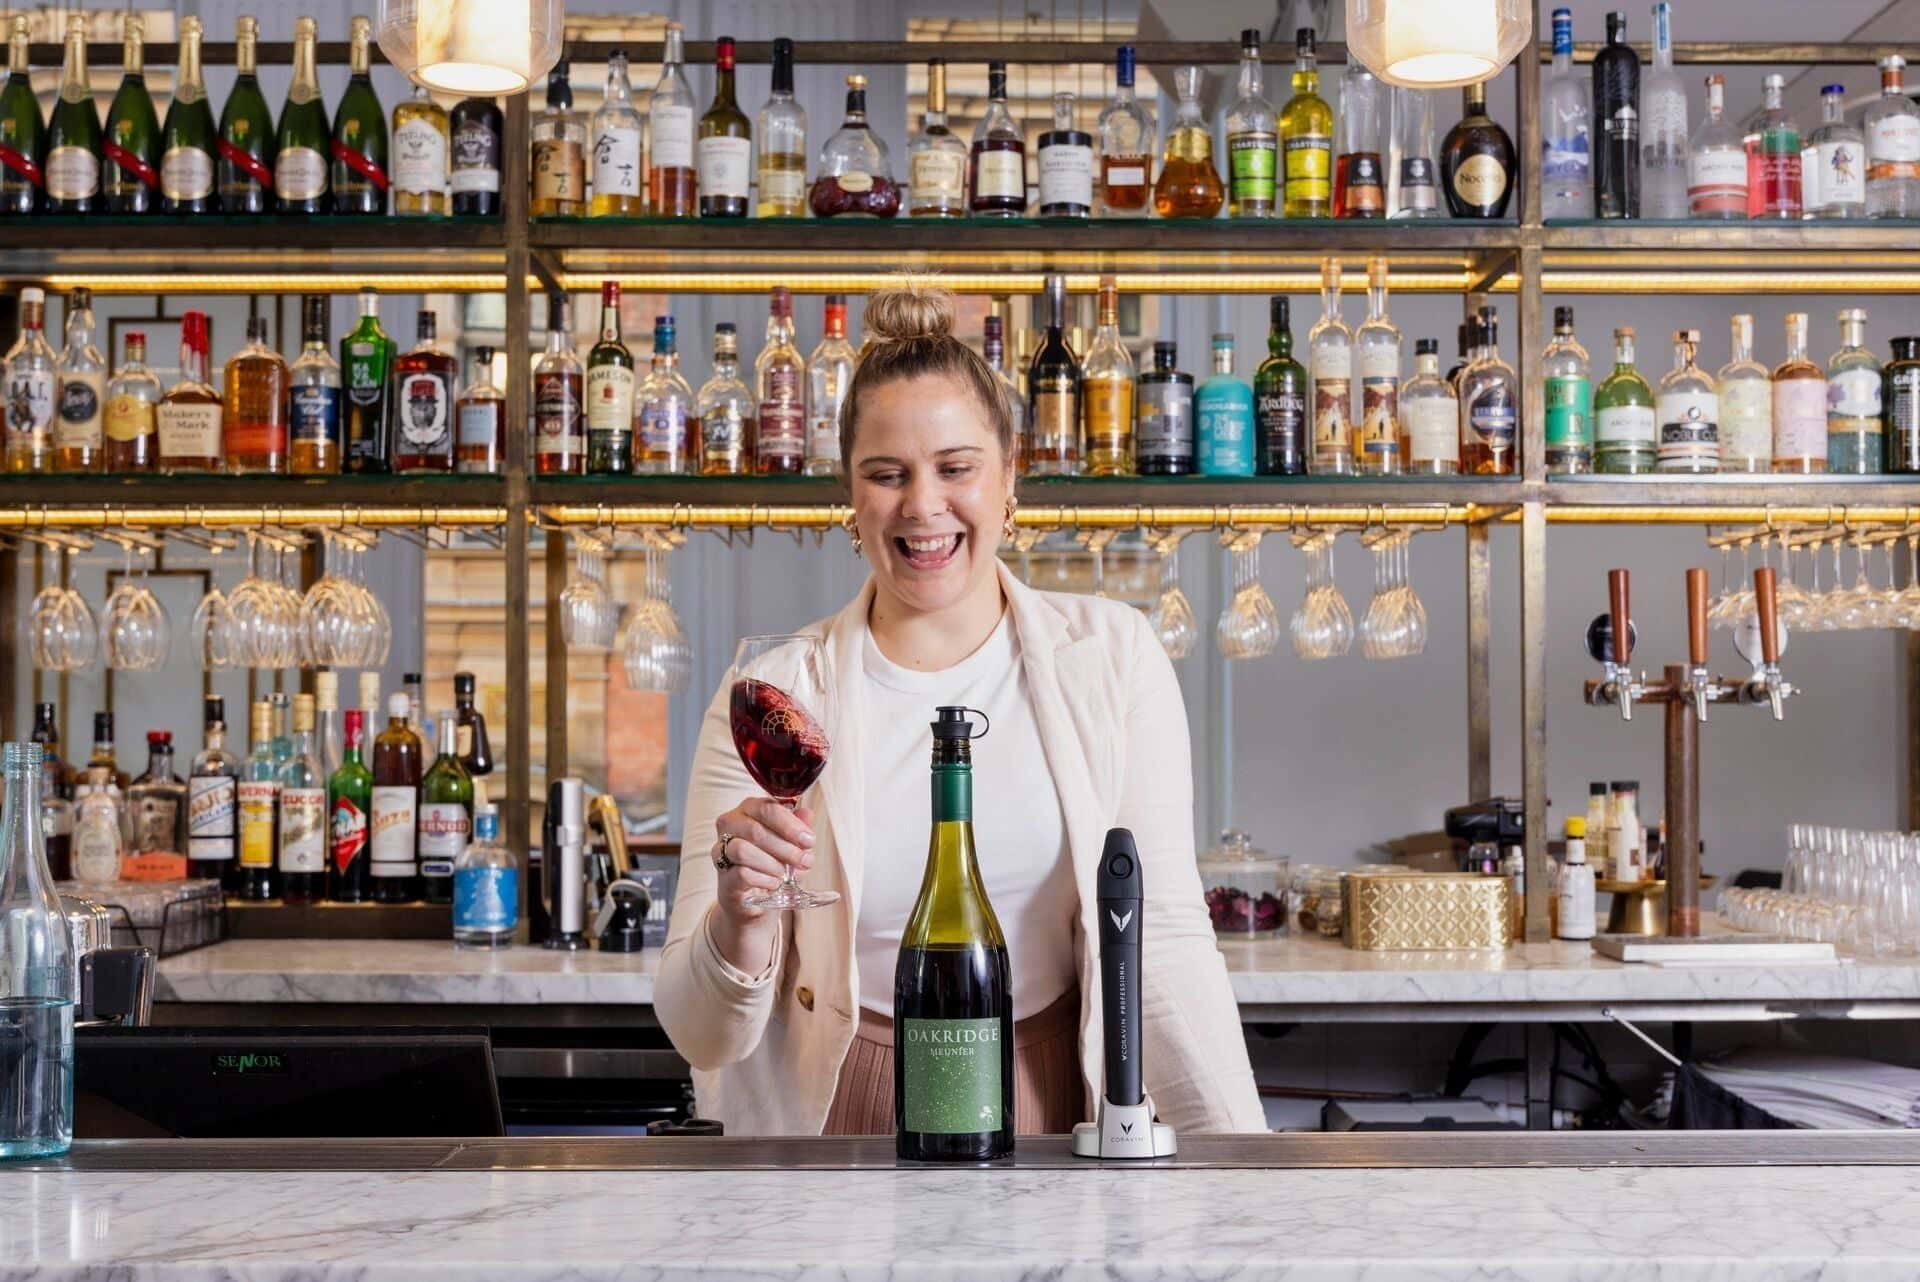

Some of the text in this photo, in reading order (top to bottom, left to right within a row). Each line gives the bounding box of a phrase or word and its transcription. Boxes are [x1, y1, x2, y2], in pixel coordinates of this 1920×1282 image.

[1663, 429, 1698, 442] NOBLE
[907, 1027, 1000, 1043] OAKRIDGE
[930, 1046, 977, 1057] MEUNIER
